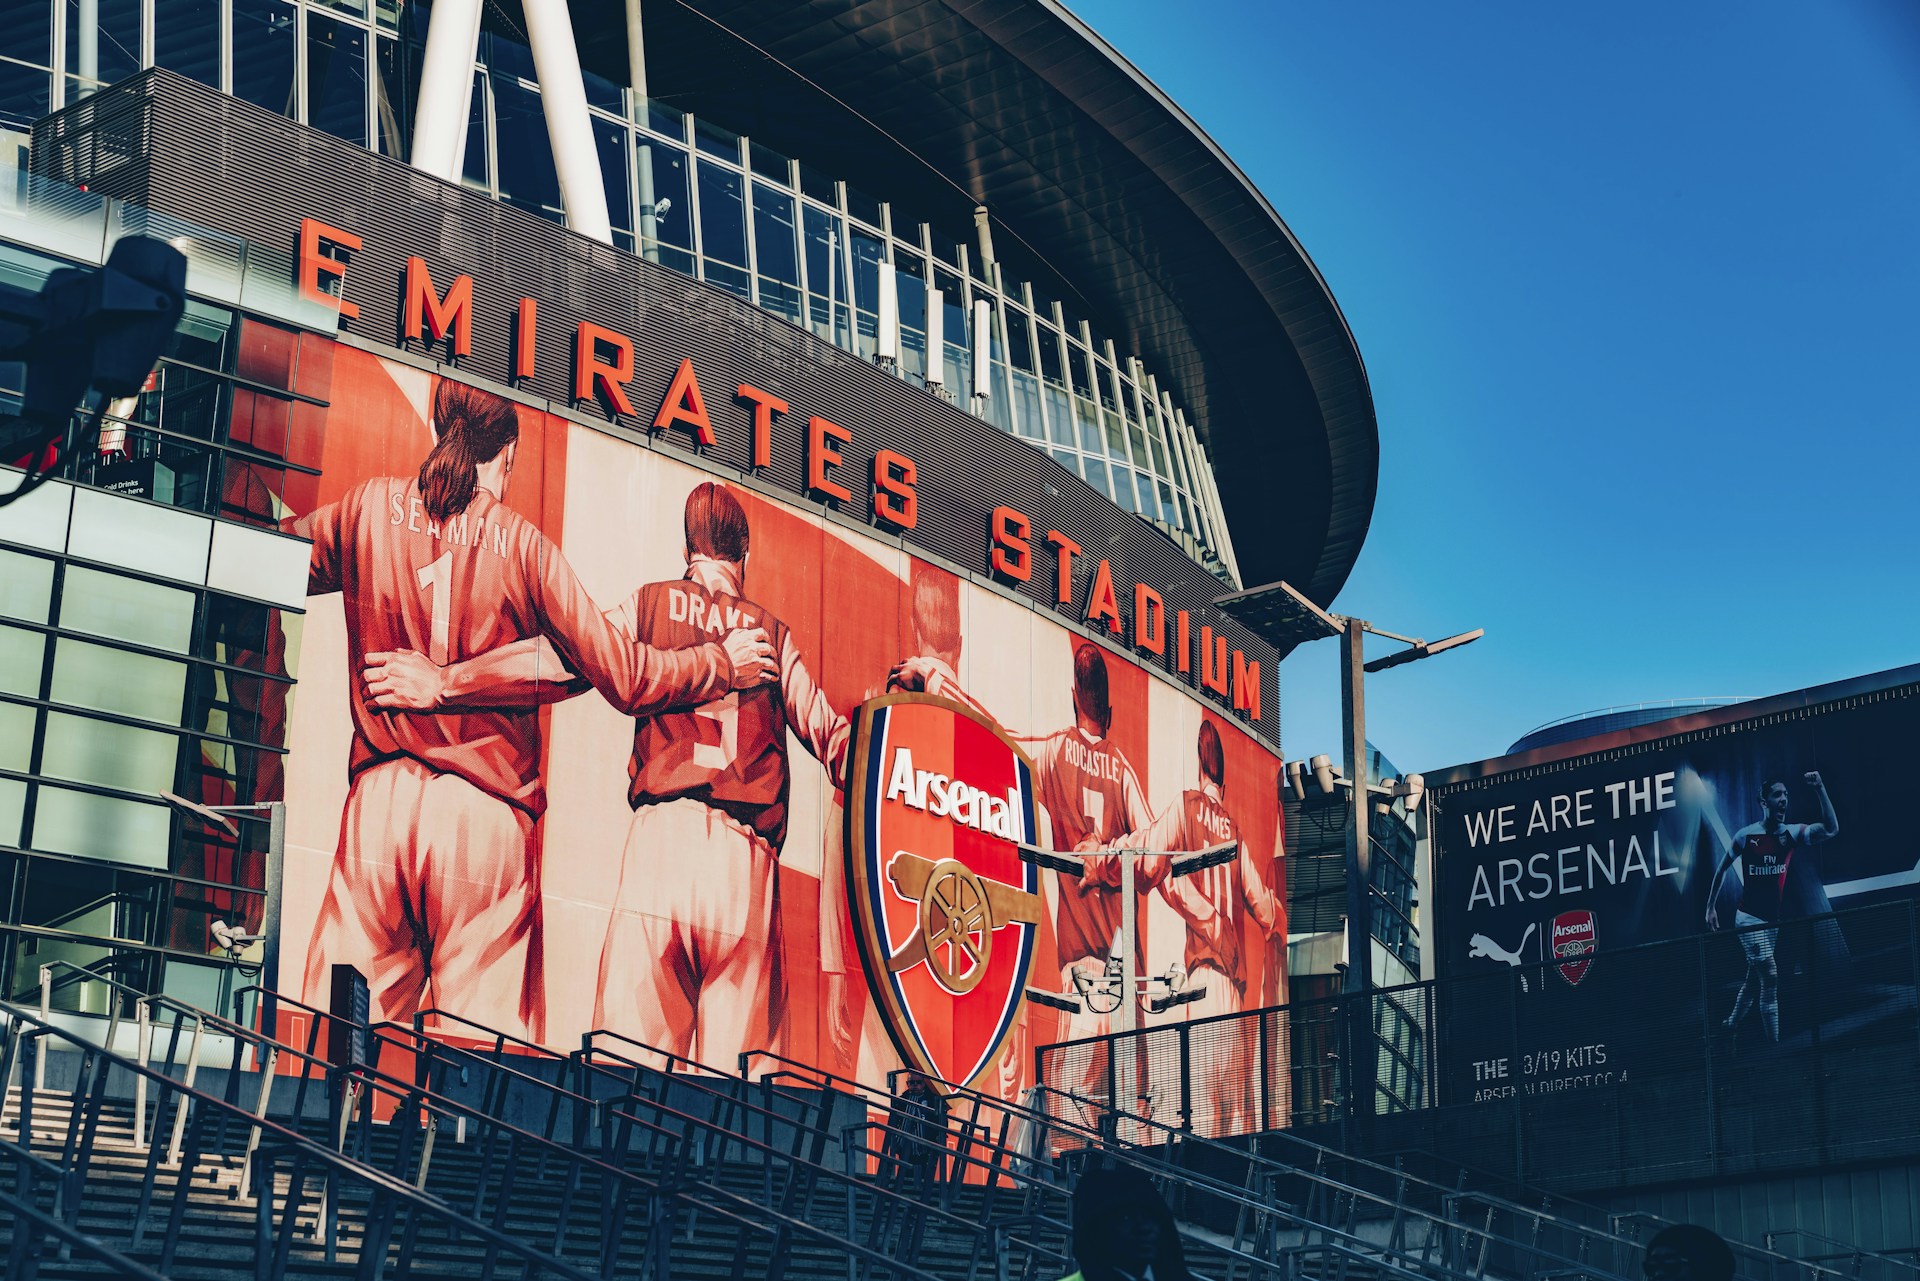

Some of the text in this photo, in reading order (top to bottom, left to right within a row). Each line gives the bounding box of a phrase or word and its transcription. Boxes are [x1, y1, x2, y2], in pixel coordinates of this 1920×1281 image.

[118, 480, 139, 488] Drinks
[299, 218, 1261, 721] EMIRATES STADIUM
[390, 492, 508, 559] SEAMAN
[1065, 737, 1120, 784] ROCASTLE
[886, 747, 1021, 843] Arsenal
[1464, 771, 1677, 848] WE ARE THE
[1196, 802, 1231, 840] JAMES
[1467, 830, 1680, 911] ARSENAL
[1749, 863, 1787, 876] Emirates
[1763, 855, 1777, 864] Fly
[1554, 920, 1592, 937] Arsenal
[1472, 1058, 1509, 1081] THE
[1566, 1044, 1607, 1069] KITS
